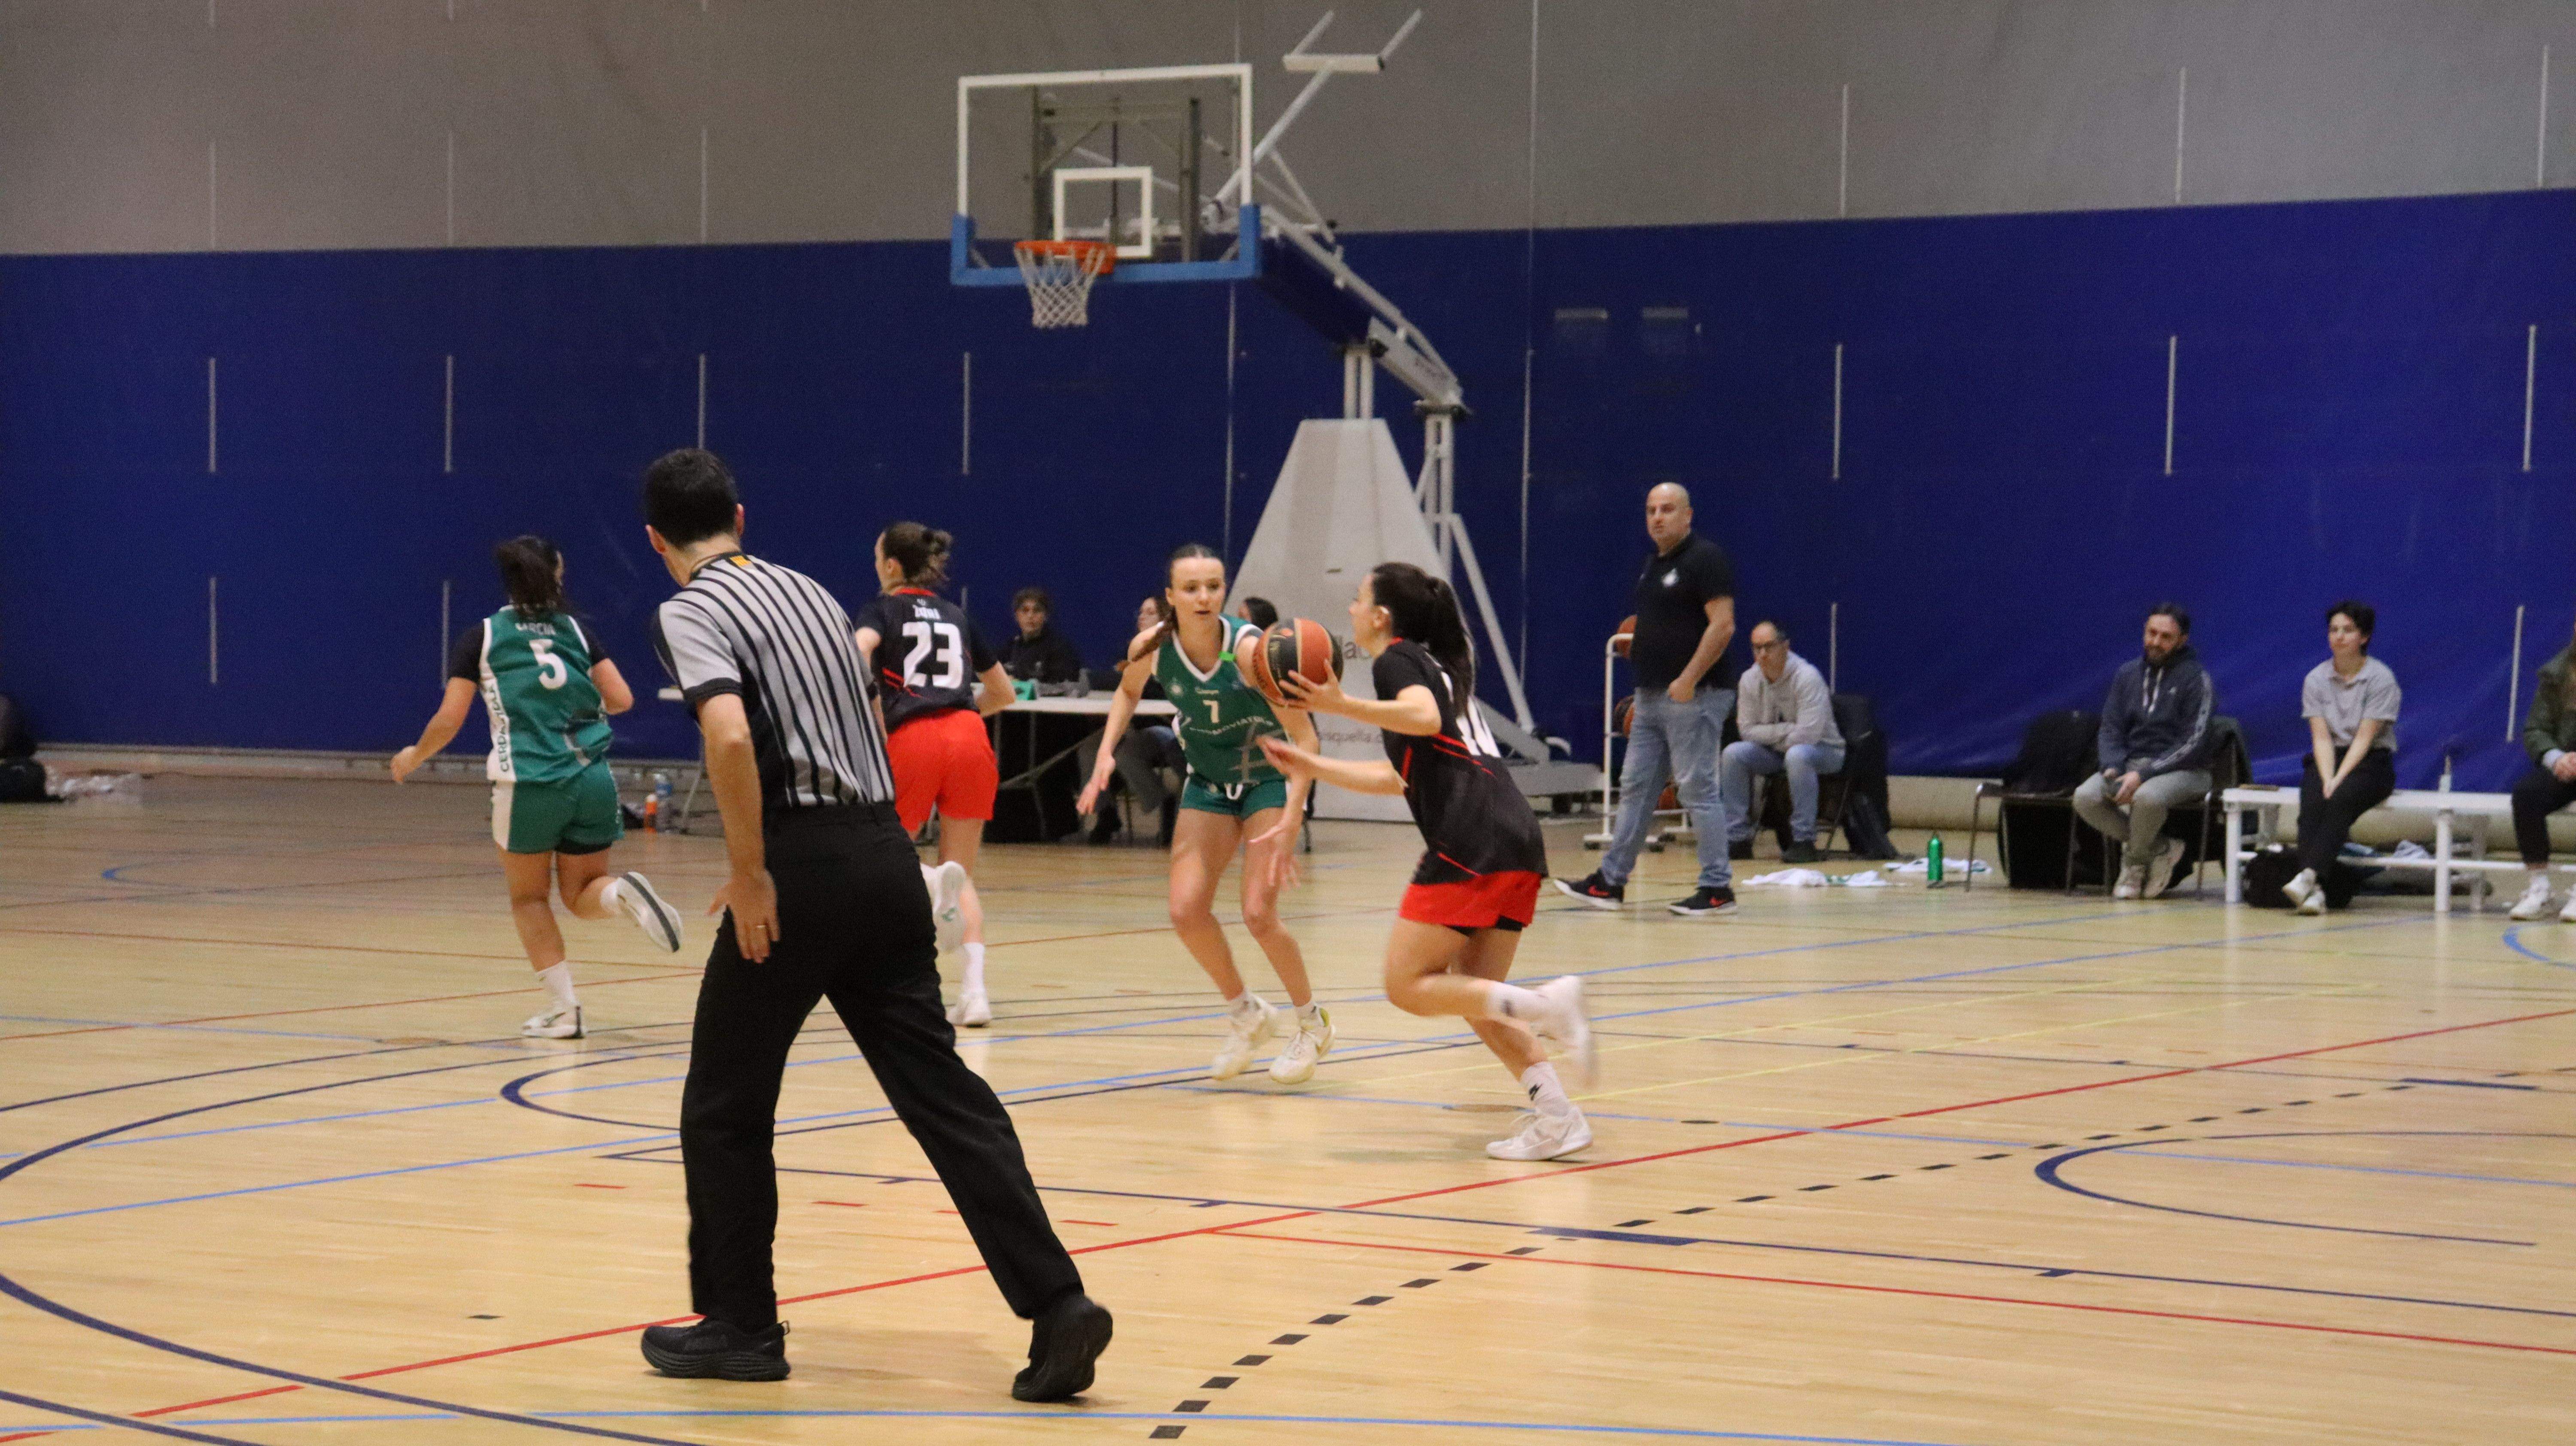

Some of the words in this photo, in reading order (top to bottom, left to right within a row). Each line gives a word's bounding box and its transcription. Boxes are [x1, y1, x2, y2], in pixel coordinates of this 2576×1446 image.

[529, 639, 567, 690] 5
[902, 621, 963, 689] 23
[1203, 699, 1219, 724] 7
